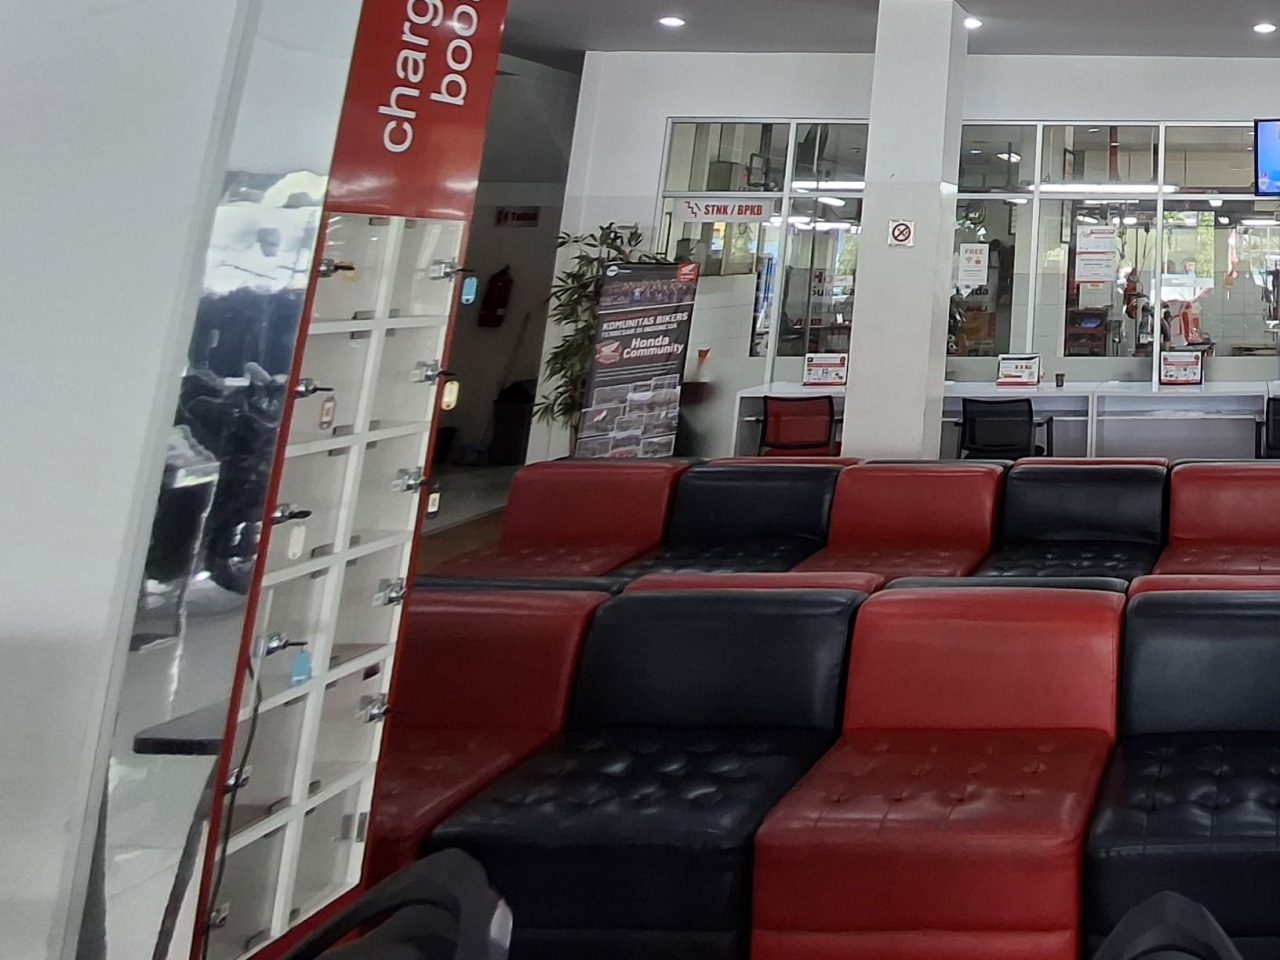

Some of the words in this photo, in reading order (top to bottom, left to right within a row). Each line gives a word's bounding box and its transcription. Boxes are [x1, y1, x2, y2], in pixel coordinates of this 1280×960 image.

[704, 204, 729, 216] STNK
[737, 204, 763, 216] BPKB
[602, 316, 655, 331] KOMUNITAS
[656, 312, 689, 324] BIKERS
[631, 335, 670, 349] Honda
[623, 343, 685, 359] Community
